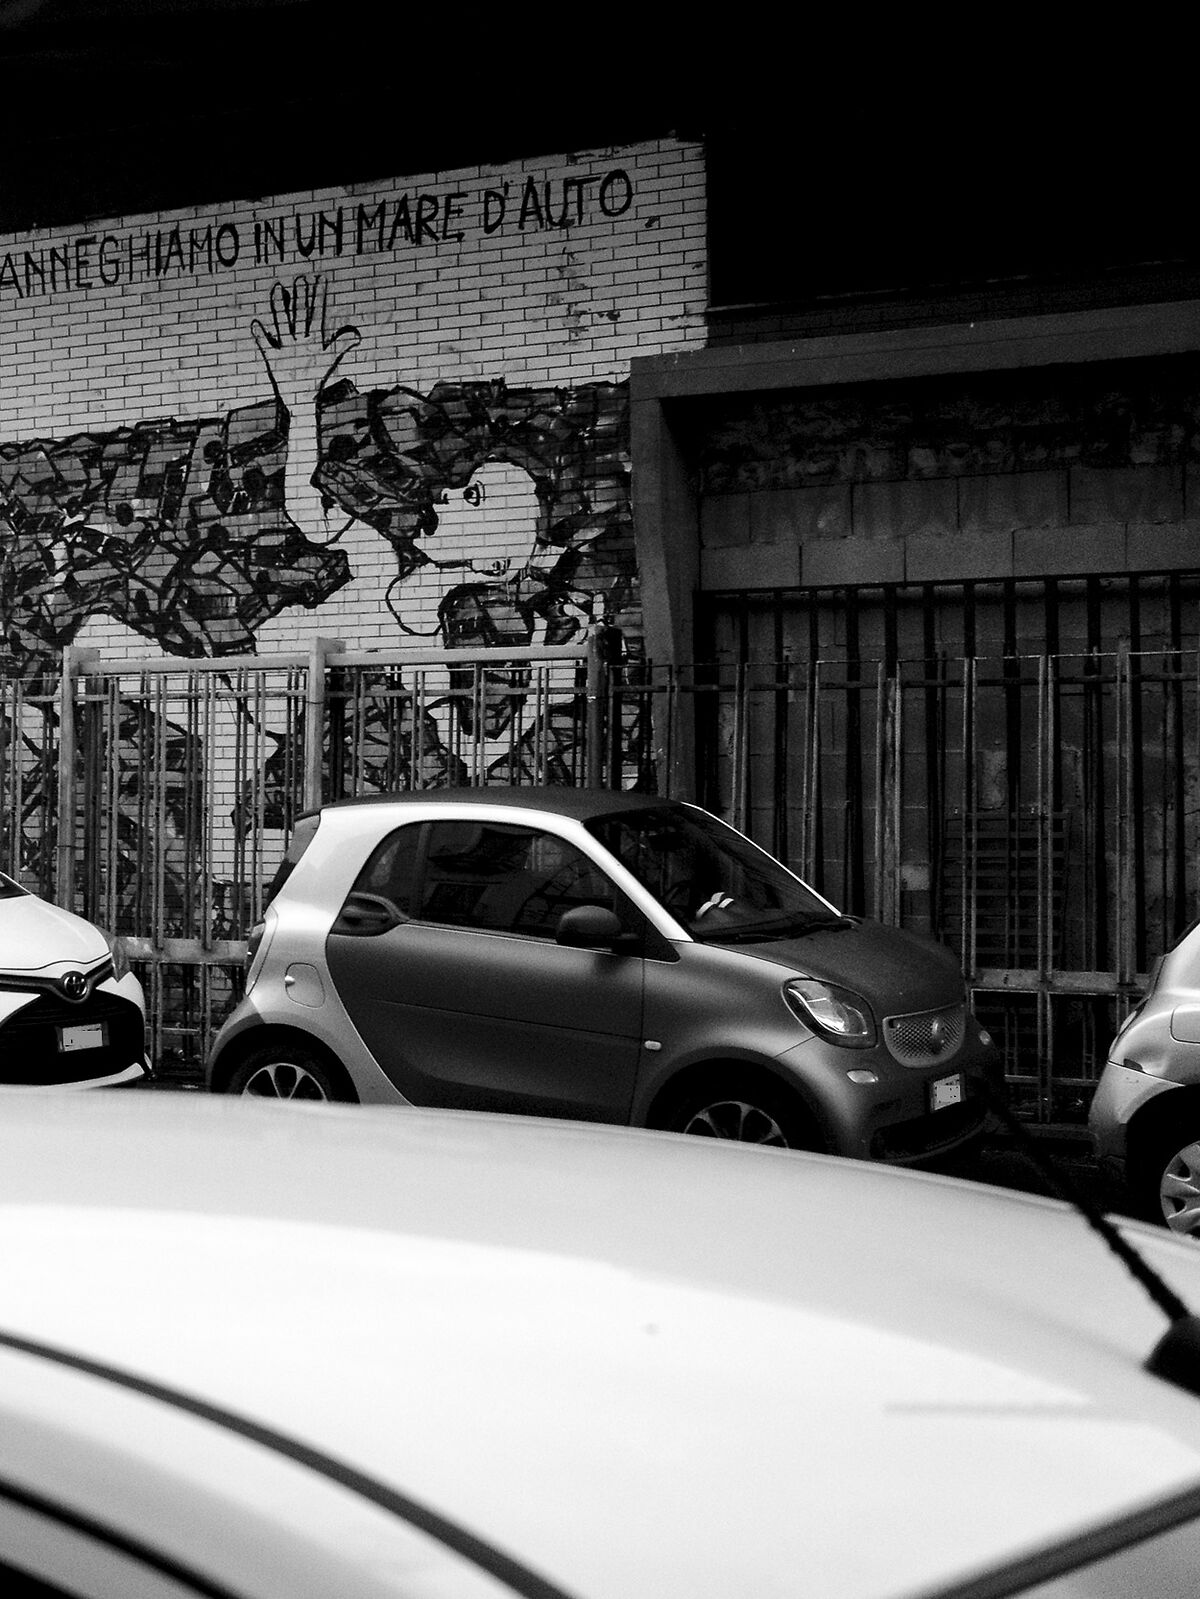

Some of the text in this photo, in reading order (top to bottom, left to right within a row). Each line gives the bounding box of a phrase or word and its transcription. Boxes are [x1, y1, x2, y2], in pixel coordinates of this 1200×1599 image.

[254, 215, 285, 264] IN
[296, 206, 344, 257] UN
[356, 192, 469, 252] MARE
[484, 169, 633, 234] D'AUTO
